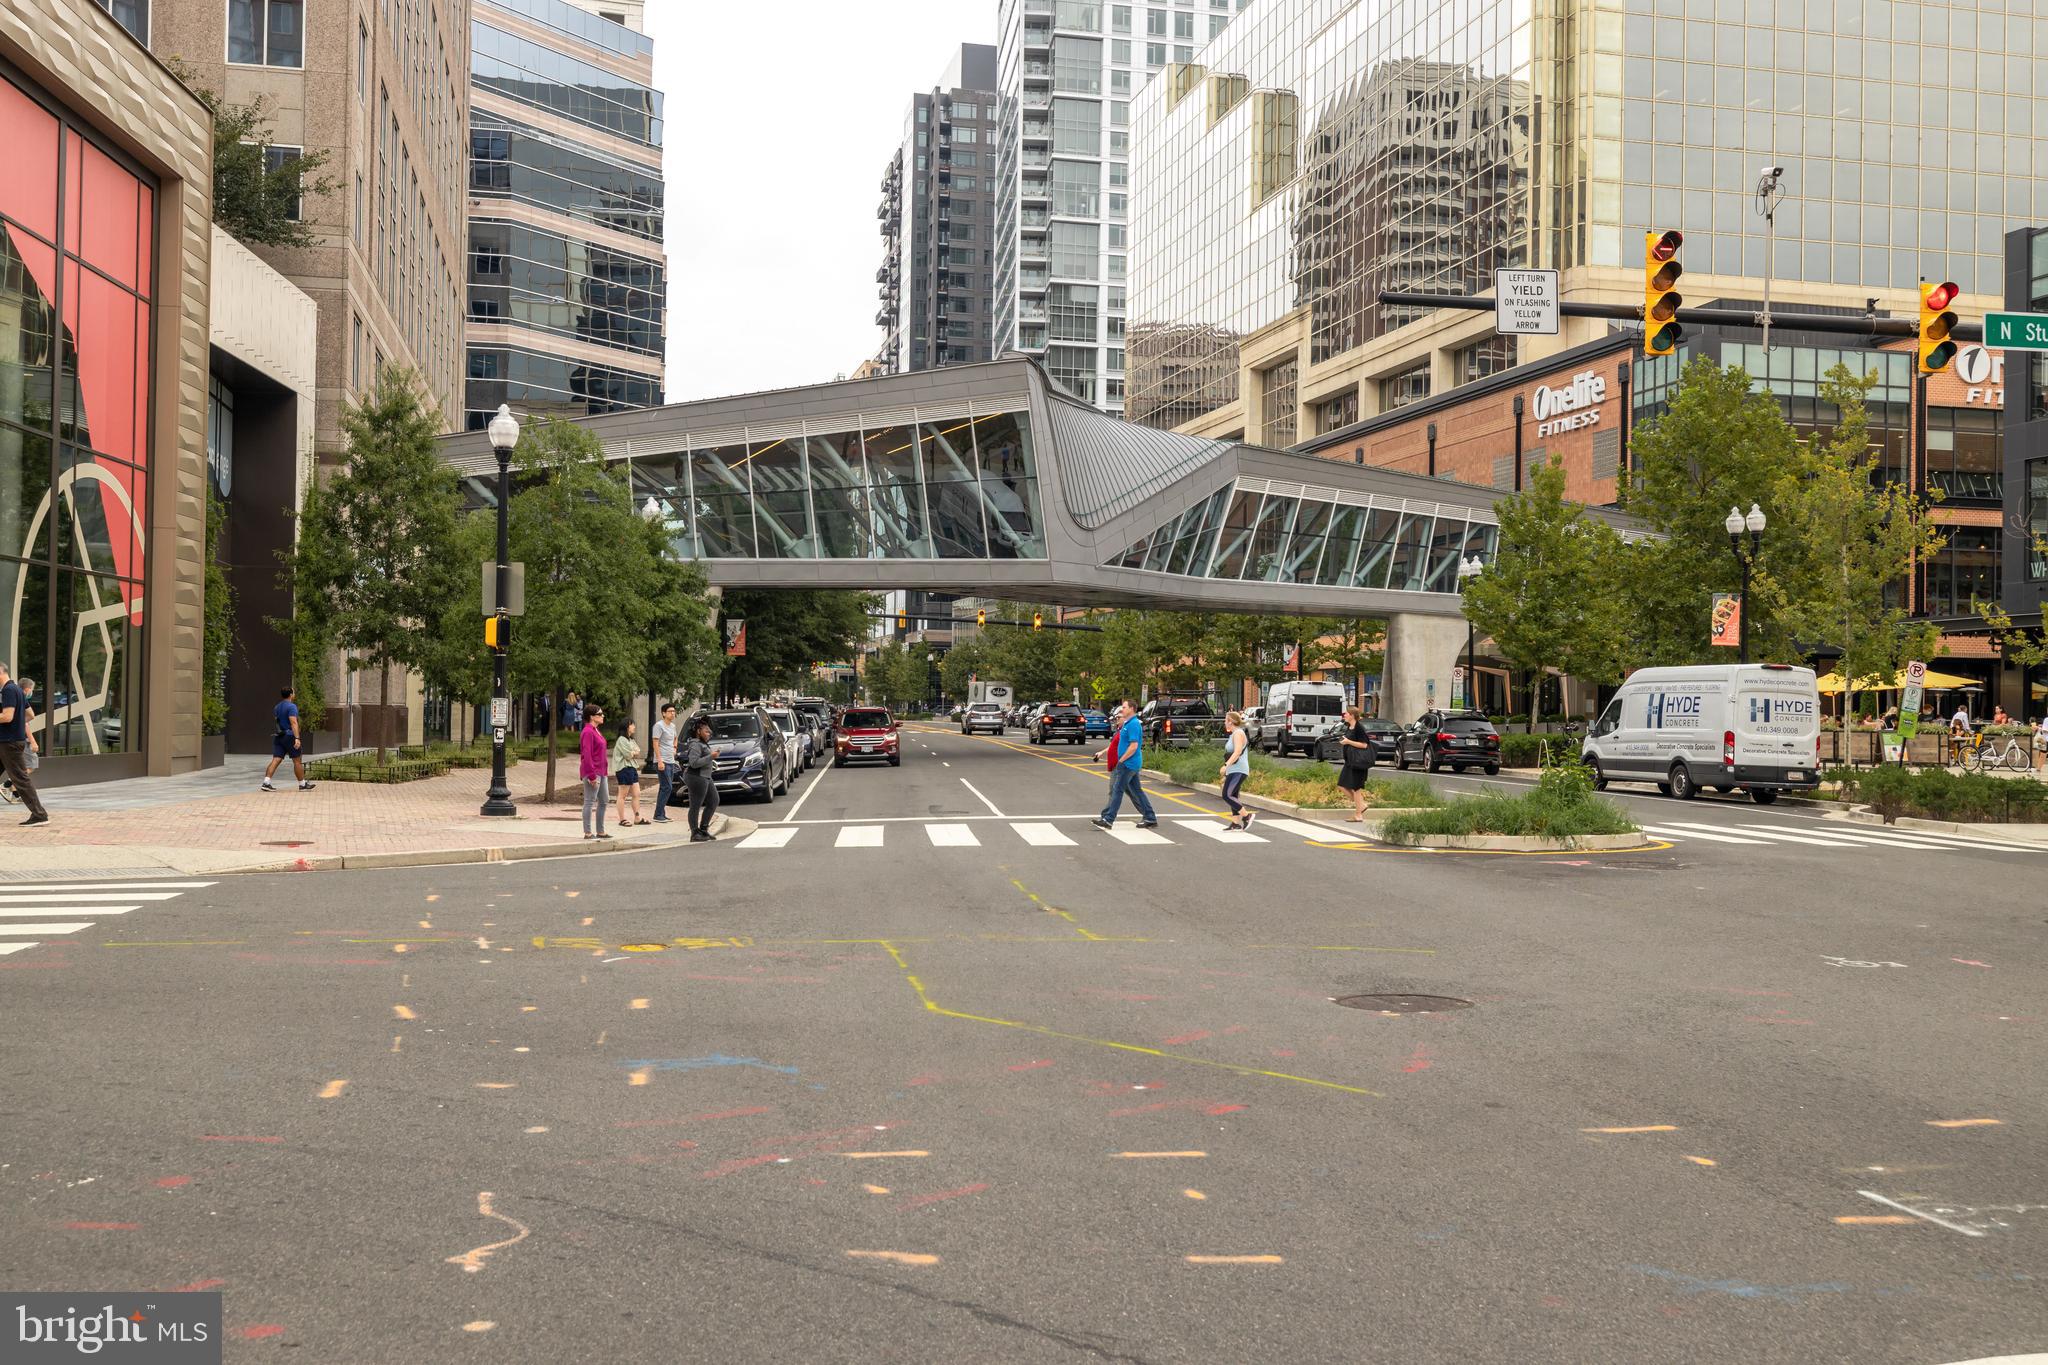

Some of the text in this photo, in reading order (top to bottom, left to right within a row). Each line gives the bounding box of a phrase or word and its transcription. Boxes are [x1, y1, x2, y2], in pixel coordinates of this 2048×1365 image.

[1509, 274, 1546, 283] LEFT TURN
[1511, 285, 1544, 296] YIELD
[1504, 298, 1551, 307] ON FLASHING
[1514, 310, 1542, 318] YELLOW
[1515, 321, 1540, 329] ARROW
[2000, 321, 2012, 340] N
[1533, 370, 1606, 421] Onelife
[1538, 408, 1600, 438] FITNESS
[1666, 696, 1701, 713] HYDE
[1774, 700, 1813, 713] HYDE
[1665, 719, 1700, 727] CONCRETE
[1774, 715, 1812, 723] CONCRETE
